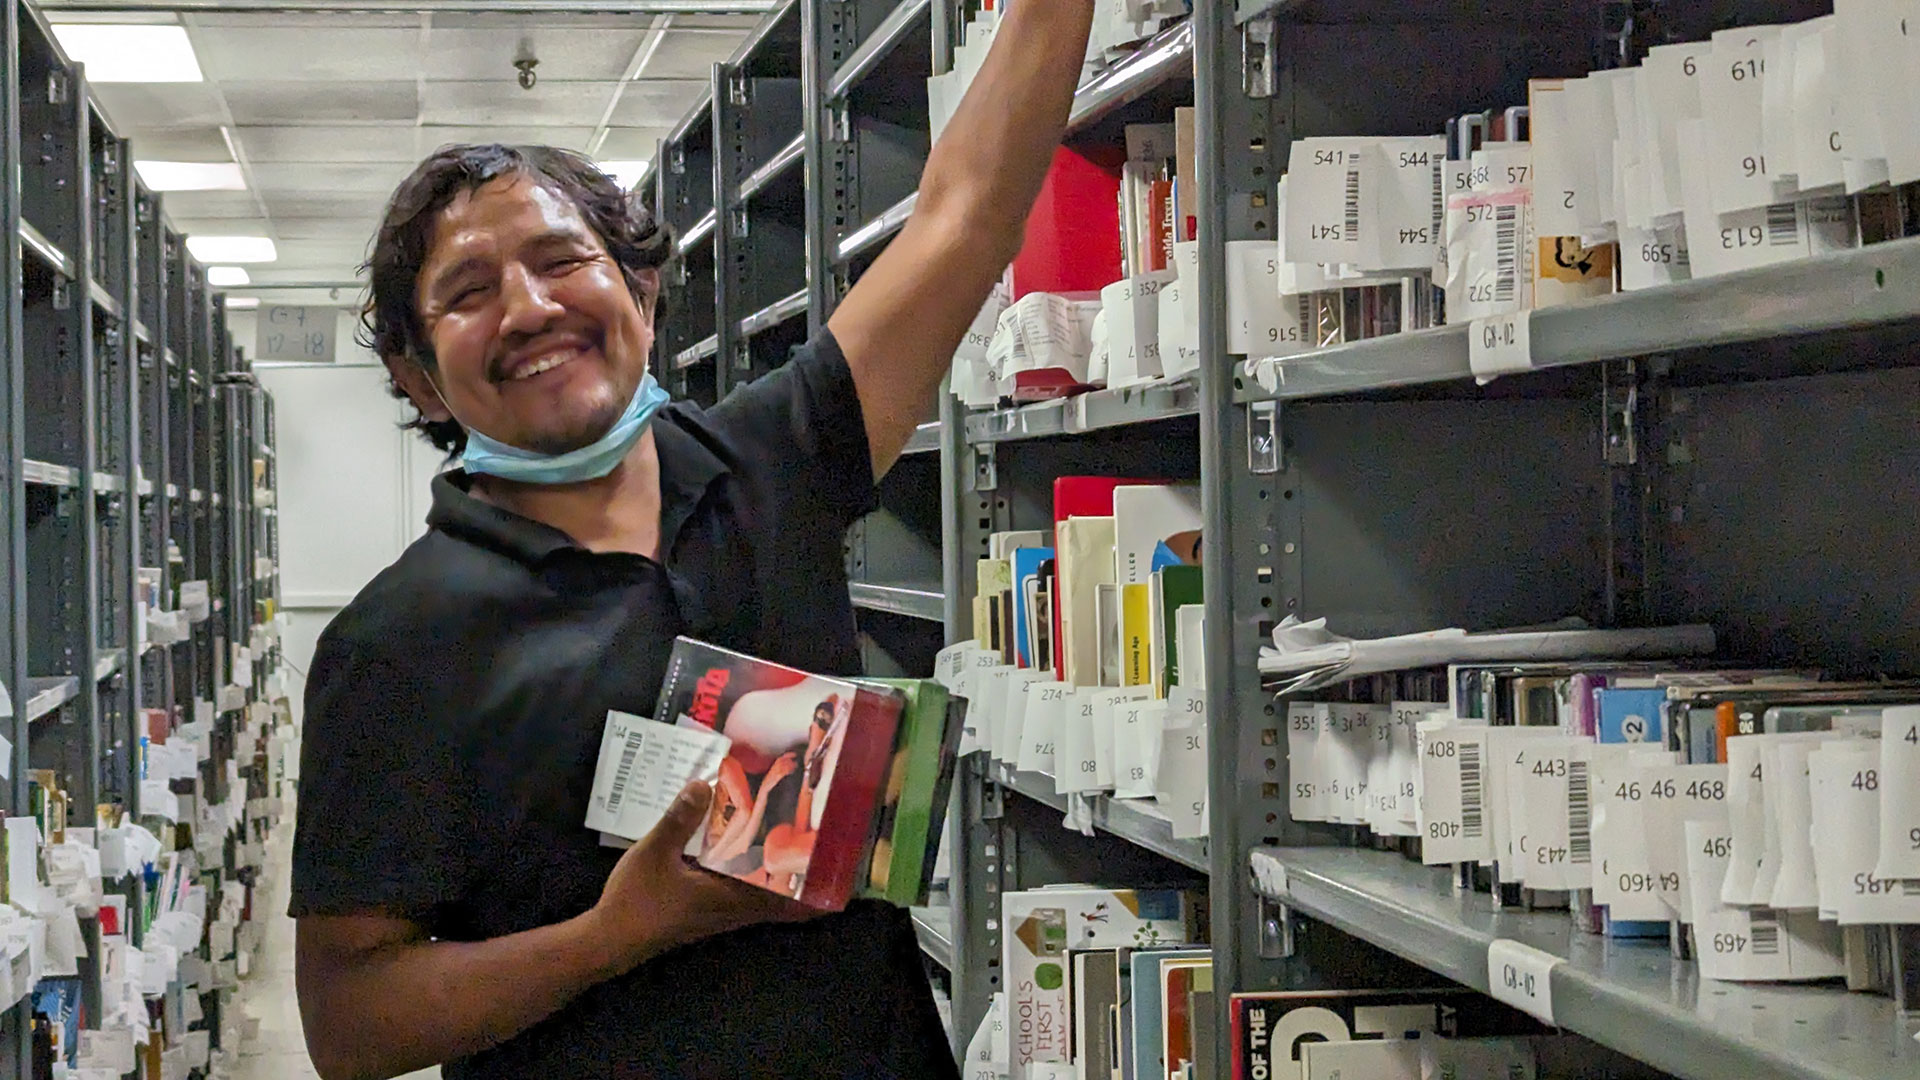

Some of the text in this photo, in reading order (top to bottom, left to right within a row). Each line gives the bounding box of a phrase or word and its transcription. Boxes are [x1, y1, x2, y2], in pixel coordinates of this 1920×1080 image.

[1314, 150, 1344, 166] 541
[1399, 151, 1429, 167] 544
[1507, 166, 1528, 184] 57
[1466, 204, 1493, 222] 572
[1311, 224, 1341, 240] 541
[1399, 228, 1428, 243] 544
[1720, 226, 1763, 249] 613
[1641, 244, 1672, 263] 599
[1139, 281, 1158, 296] 352
[1469, 285, 1492, 302] 572
[1268, 326, 1297, 342] 516
[1427, 741, 1456, 758] 408
[1532, 759, 1567, 777] 443
[1651, 779, 1676, 798] 46
[1852, 770, 1878, 790] 48
[1615, 782, 1641, 800] 46
[1686, 781, 1725, 800] 468
[1430, 822, 1459, 839] 408
[1537, 847, 1567, 864] 443
[1714, 934, 1747, 953] 469
[1017, 980, 1034, 1066] SCHOOL'S
[1034, 1000, 1053, 1051] FIRST
[1249, 1008, 1268, 1080] OF THE
